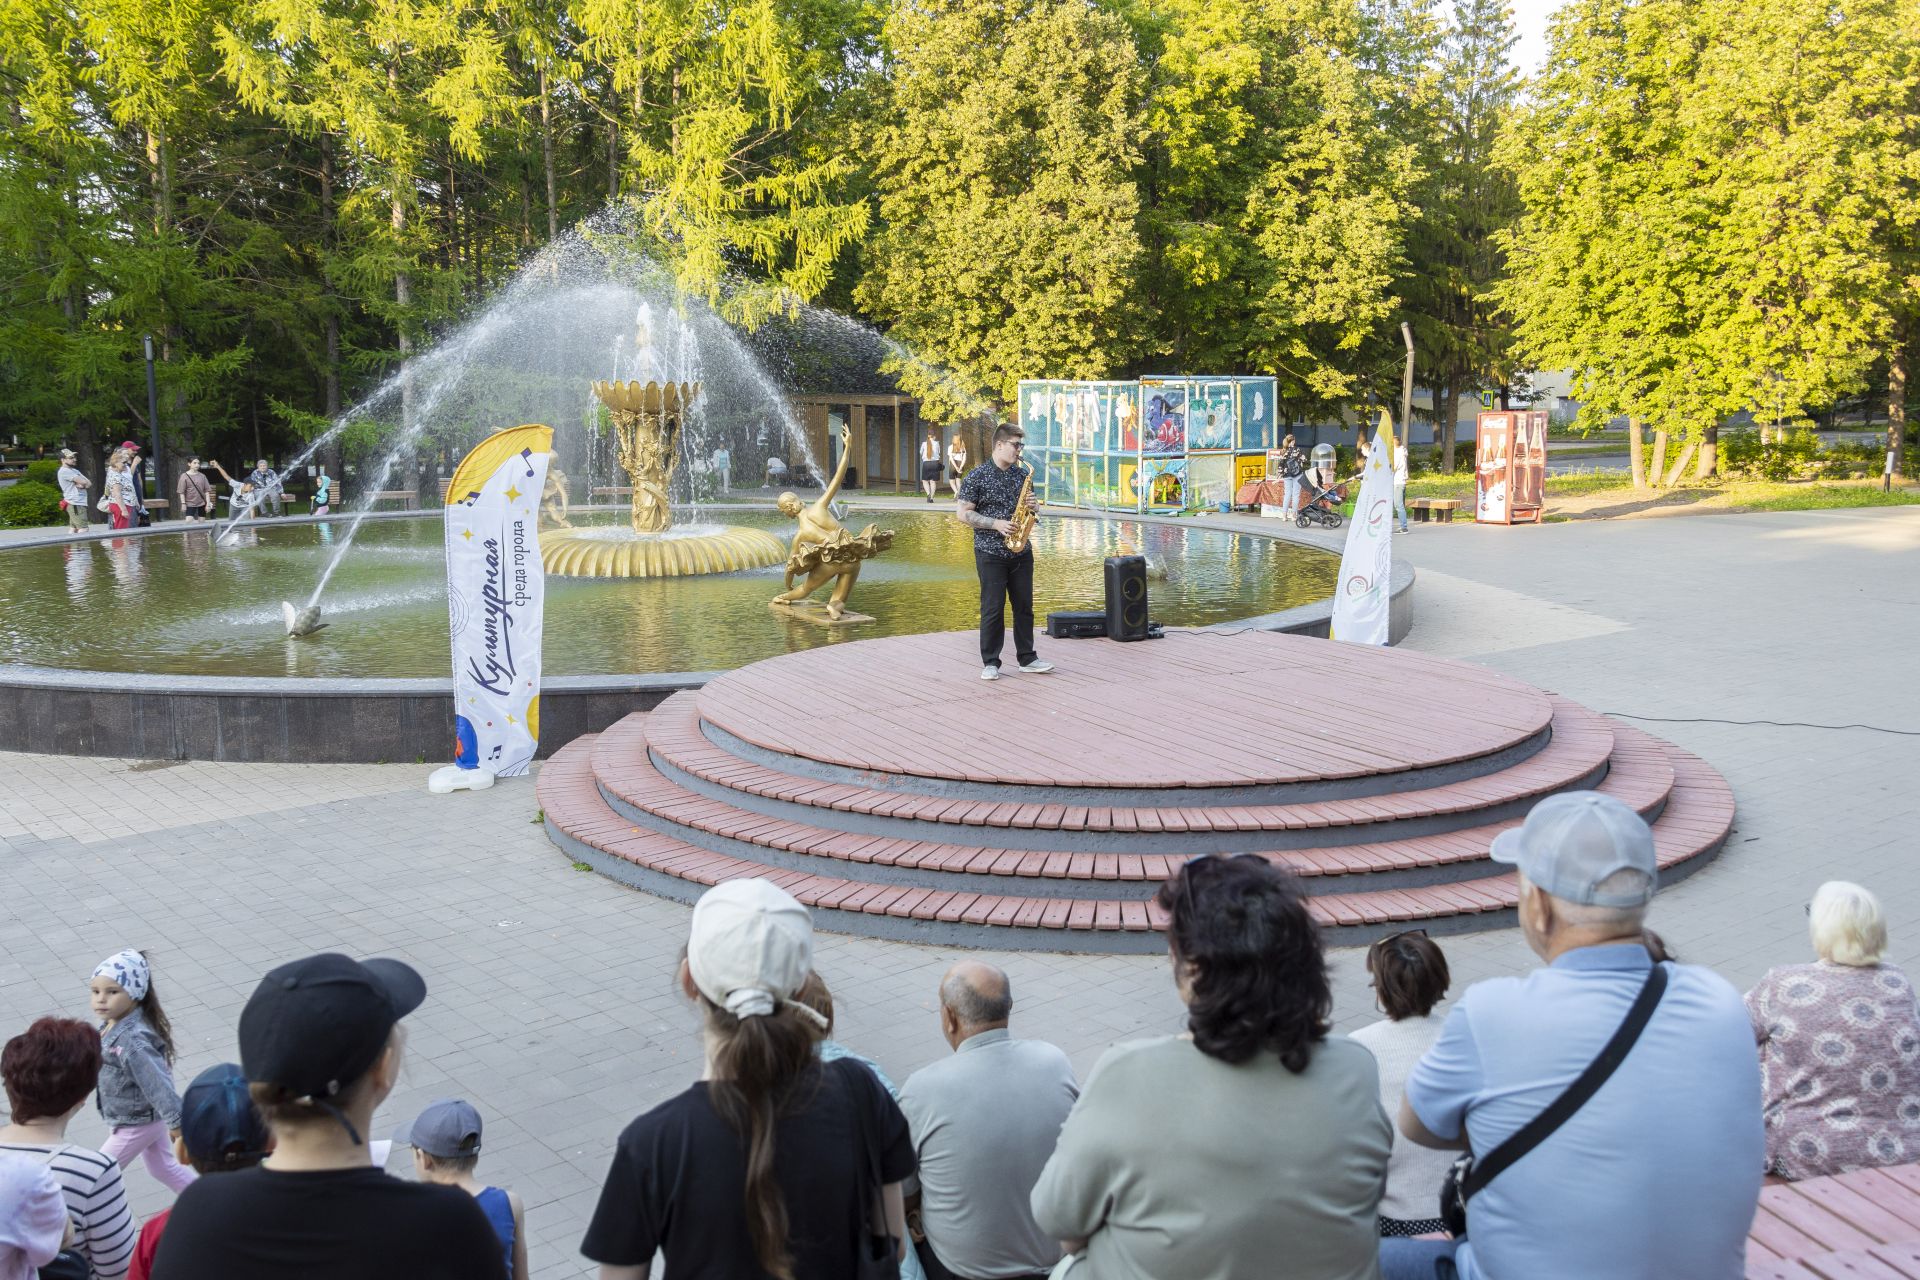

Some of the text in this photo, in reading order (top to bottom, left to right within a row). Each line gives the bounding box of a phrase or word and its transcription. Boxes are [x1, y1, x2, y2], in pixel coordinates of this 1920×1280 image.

[466, 537, 514, 697] Культурная
[513, 520, 532, 607] среда города
